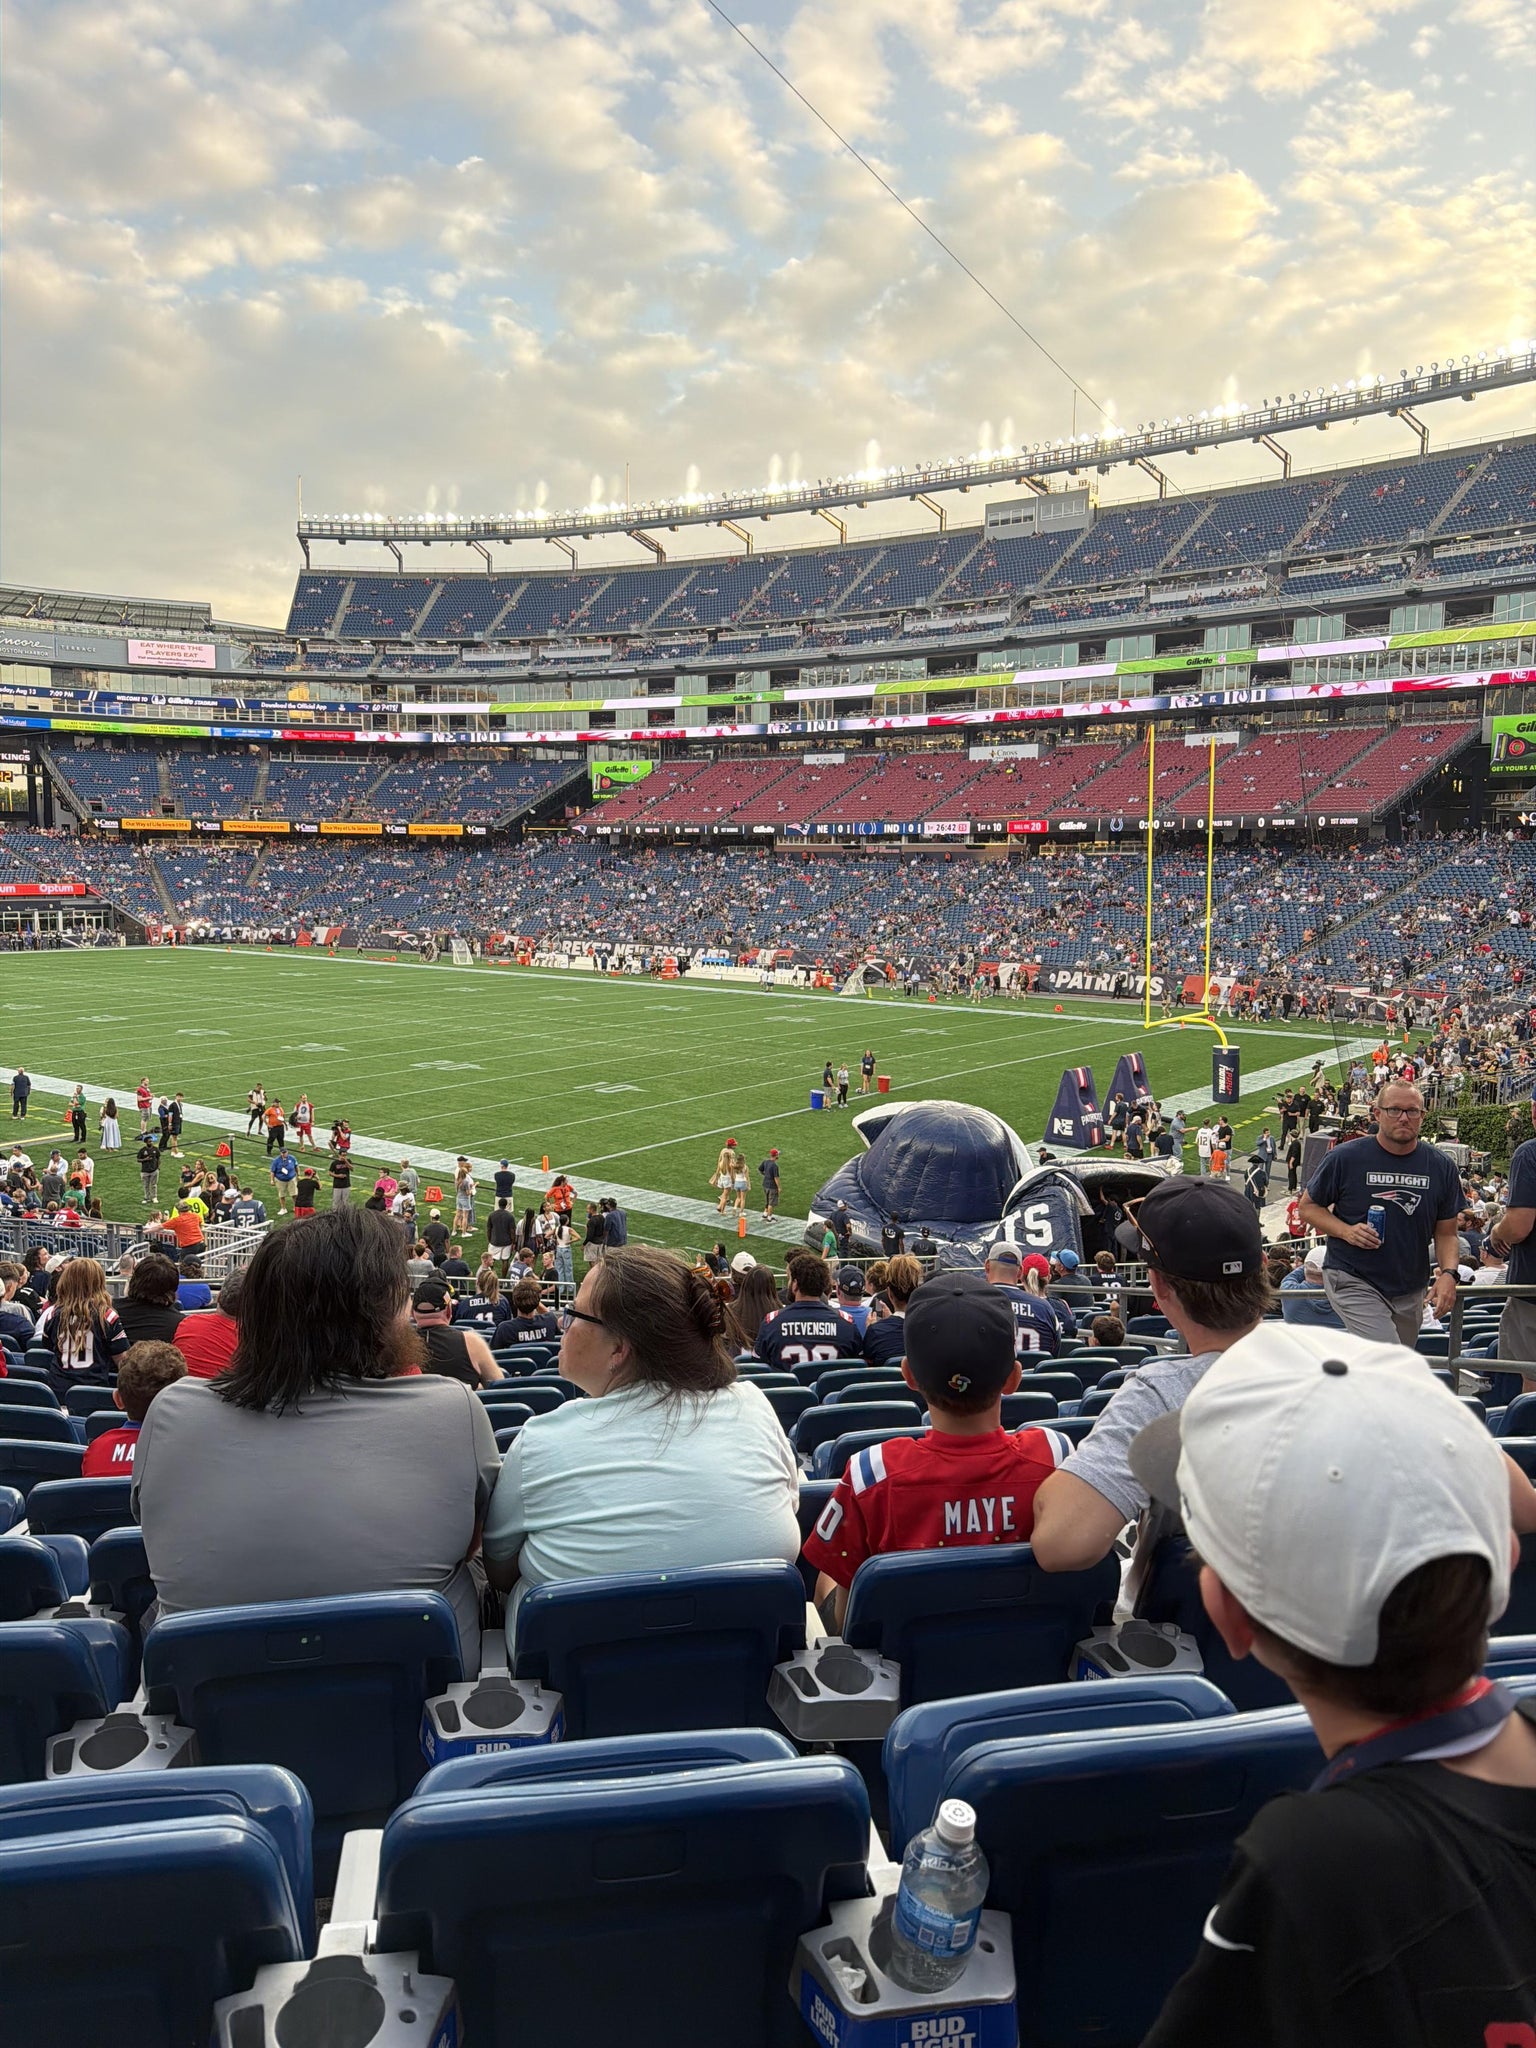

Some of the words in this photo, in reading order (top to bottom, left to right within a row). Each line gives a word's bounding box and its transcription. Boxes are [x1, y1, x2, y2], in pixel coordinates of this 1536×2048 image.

[60, 644, 97, 652] TERRACE
[1186, 658, 1213, 666] Gillette
[16, 687, 28, 696] Aug
[168, 697, 194, 705] Gillette
[372, 703, 381, 711] GO
[1495, 793, 1509, 802] ALE
[1031, 822, 1041, 831] 20
[1058, 821, 1088, 830] Gillette
[1197, 819, 1204, 829] 0
[1258, 817, 1265, 828] 0
[1318, 816, 1326, 827] 0
[596, 826, 612, 834] 0:00
[635, 826, 641, 834] 0
[675, 826, 681, 834] 0
[713, 826, 719, 834] 0
[817, 824, 829, 834] NE
[837, 824, 843, 834] 0
[884, 823, 900, 833] IND
[908, 823, 914, 833] 0
[935, 824, 957, 832] 26:42
[993, 822, 1002, 832] 10
[39, 883, 74, 895] Optum
[1053, 1117, 1074, 1136] NE
[1200, 1136, 1208, 1146] 12
[1369, 1174, 1394, 1184] BUD
[1394, 1175, 1428, 1187] LIGHT
[237, 1214, 255, 1228] 32
[518, 1327, 547, 1341] BRADY
[781, 1321, 837, 1337] STEVENSON
[112, 1443, 134, 1462] MA
[944, 1496, 1016, 1536] MAYE
[475, 1742, 511, 1755] BUD
[814, 1994, 836, 2031] BUD
[810, 2004, 840, 2048] LIGHT
[911, 2015, 966, 2041] BUD
[900, 2032, 977, 2048] LIGHT
